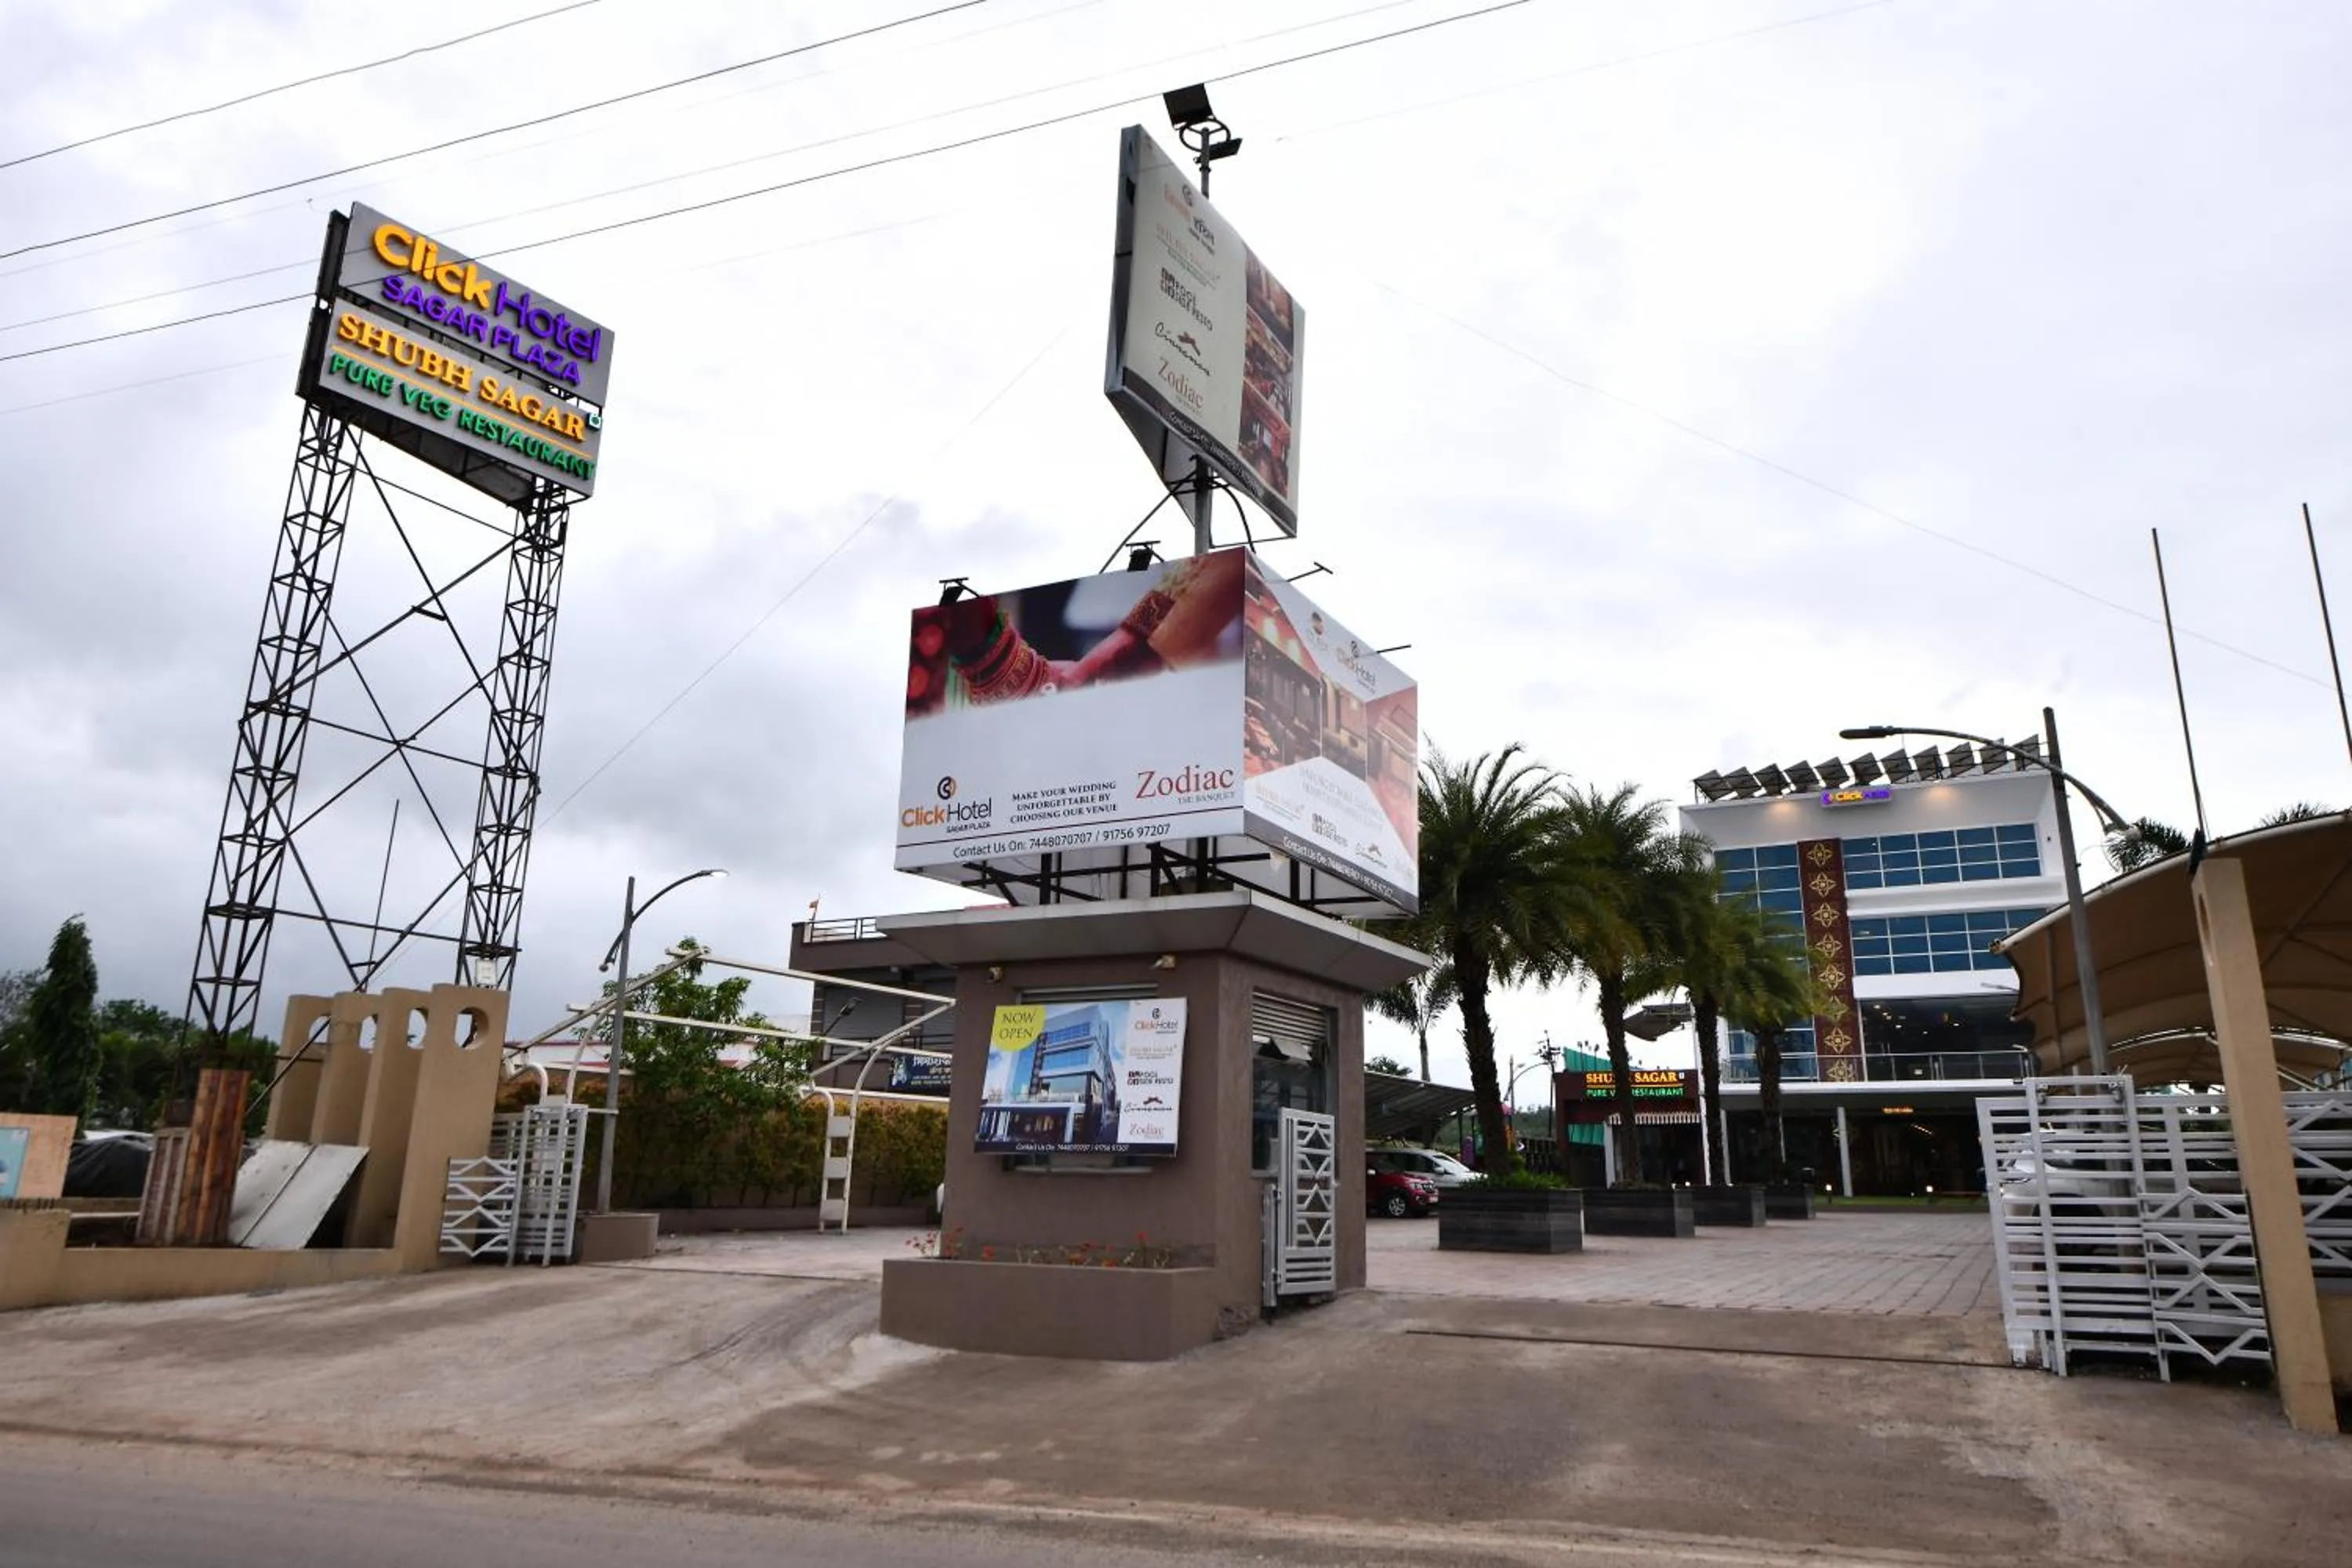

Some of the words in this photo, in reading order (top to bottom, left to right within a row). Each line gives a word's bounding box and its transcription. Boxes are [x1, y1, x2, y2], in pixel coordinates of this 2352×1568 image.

[372, 223, 492, 309] Click
[494, 281, 601, 362] Hotel
[382, 275, 488, 343] SAGAR
[491, 325, 581, 385] PLAZA
[338, 314, 474, 393] SHUBH
[478, 376, 585, 442] SAGAR
[1158, 357, 1204, 408] Zodiac
[329, 354, 394, 397] PURE
[398, 382, 453, 421] VEG
[458, 409, 595, 481] RESTAURANT
[1012, 791, 1038, 800] MAKE
[1040, 788, 1066, 797] YOUR
[1069, 781, 1116, 793] WEDDING
[1136, 764, 1236, 799] Zodiac
[902, 804, 946, 827] Click
[946, 797, 992, 822] Hotel
[1010, 810, 1061, 823] CHOOSING
[1063, 808, 1083, 816] OUR
[1086, 804, 1117, 814] VENUE
[1017, 794, 1096, 811] UNFORGETTABLE
[1098, 793, 1111, 802] BY
[953, 844, 991, 858] Contact
[993, 841, 1006, 854] Us
[1008, 840, 1026, 851] On:
[1029, 832, 1092, 848] 7448070707
[1103, 827, 1134, 841] 91756
[1137, 822, 1171, 837] 97207
[969, 822, 991, 830] PLAZA
[1003, 1012, 1035, 1023] NOW
[1000, 1028, 1033, 1040] OPEN
[1635, 1072, 1677, 1082] SAGAR
